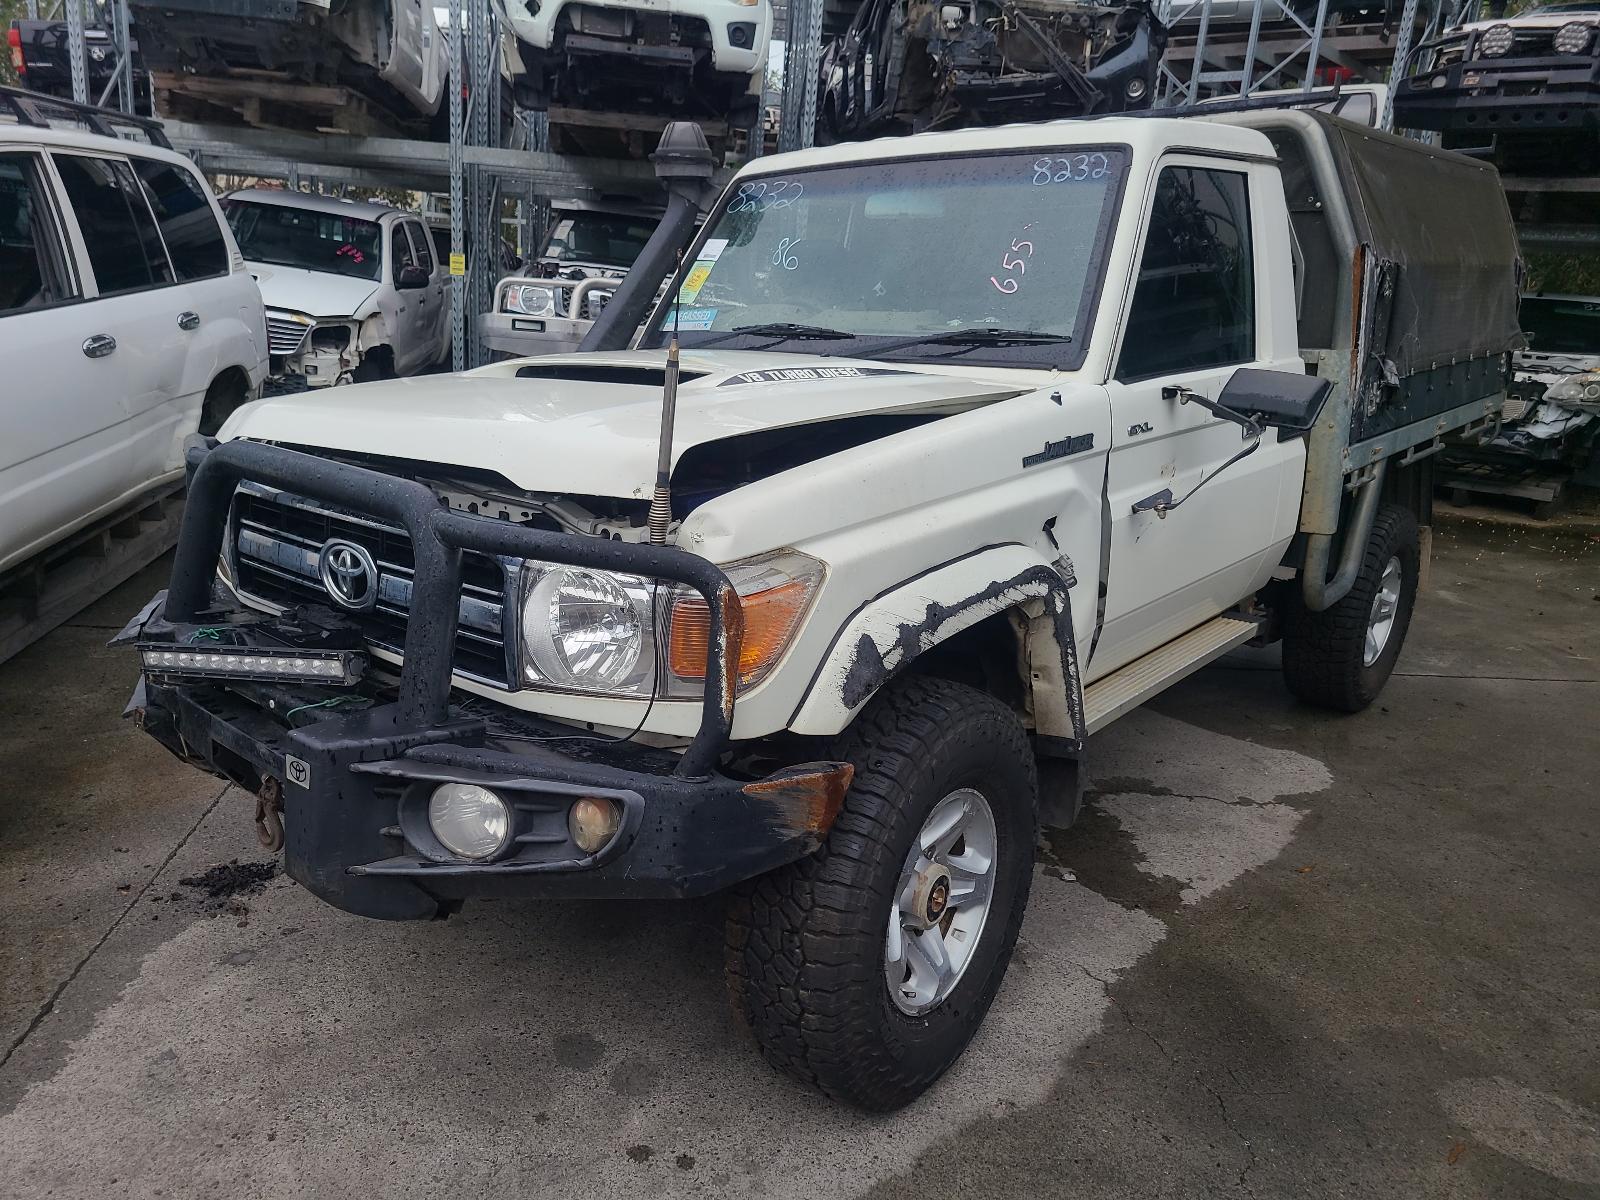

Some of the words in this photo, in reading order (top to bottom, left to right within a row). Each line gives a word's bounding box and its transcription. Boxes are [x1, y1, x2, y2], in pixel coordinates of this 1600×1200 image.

[1032, 153, 1112, 186] 8232
[727, 182, 803, 213] 8232
[772, 238, 801, 270] 86
[990, 237, 1033, 294] 655
[737, 373, 765, 383] V8
[765, 368, 815, 381] TURBO
[816, 367, 866, 379] DIESEL
